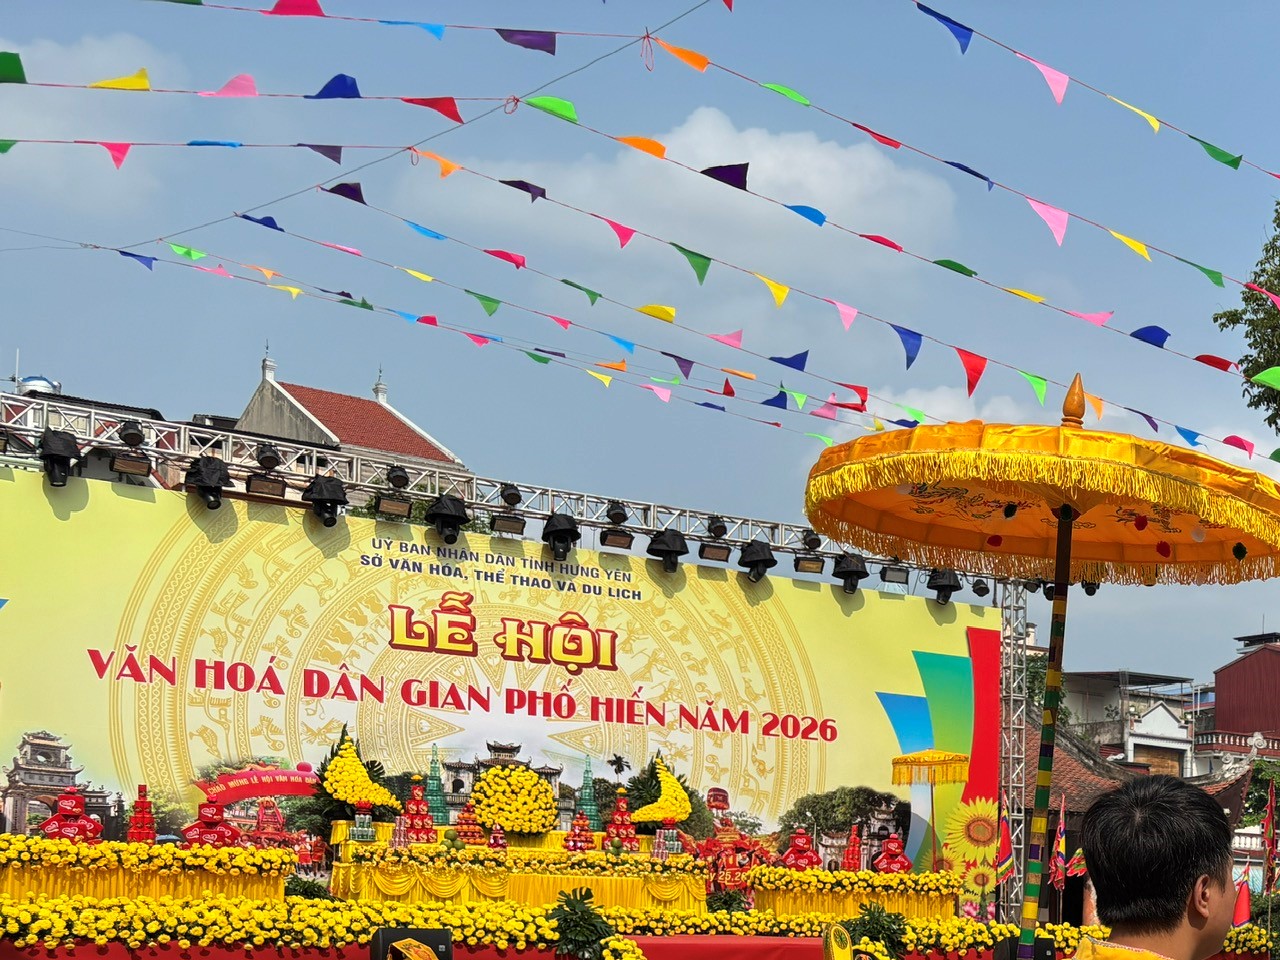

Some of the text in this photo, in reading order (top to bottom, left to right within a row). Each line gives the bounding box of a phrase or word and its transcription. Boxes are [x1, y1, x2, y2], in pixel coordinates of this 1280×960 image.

[360, 554, 642, 601] SỞ VĂN HÓA, THỂ THAO VÀ DU LỊCH
[371, 537, 632, 583] UỶ BAN NHÂN DÂN TỈNH HƯNG YÊN
[388, 590, 618, 676] LỄ HỘI
[86, 643, 839, 743] VĂN HOÁ DÂN GIAN PHỐ HIẾN NĂM 2026
